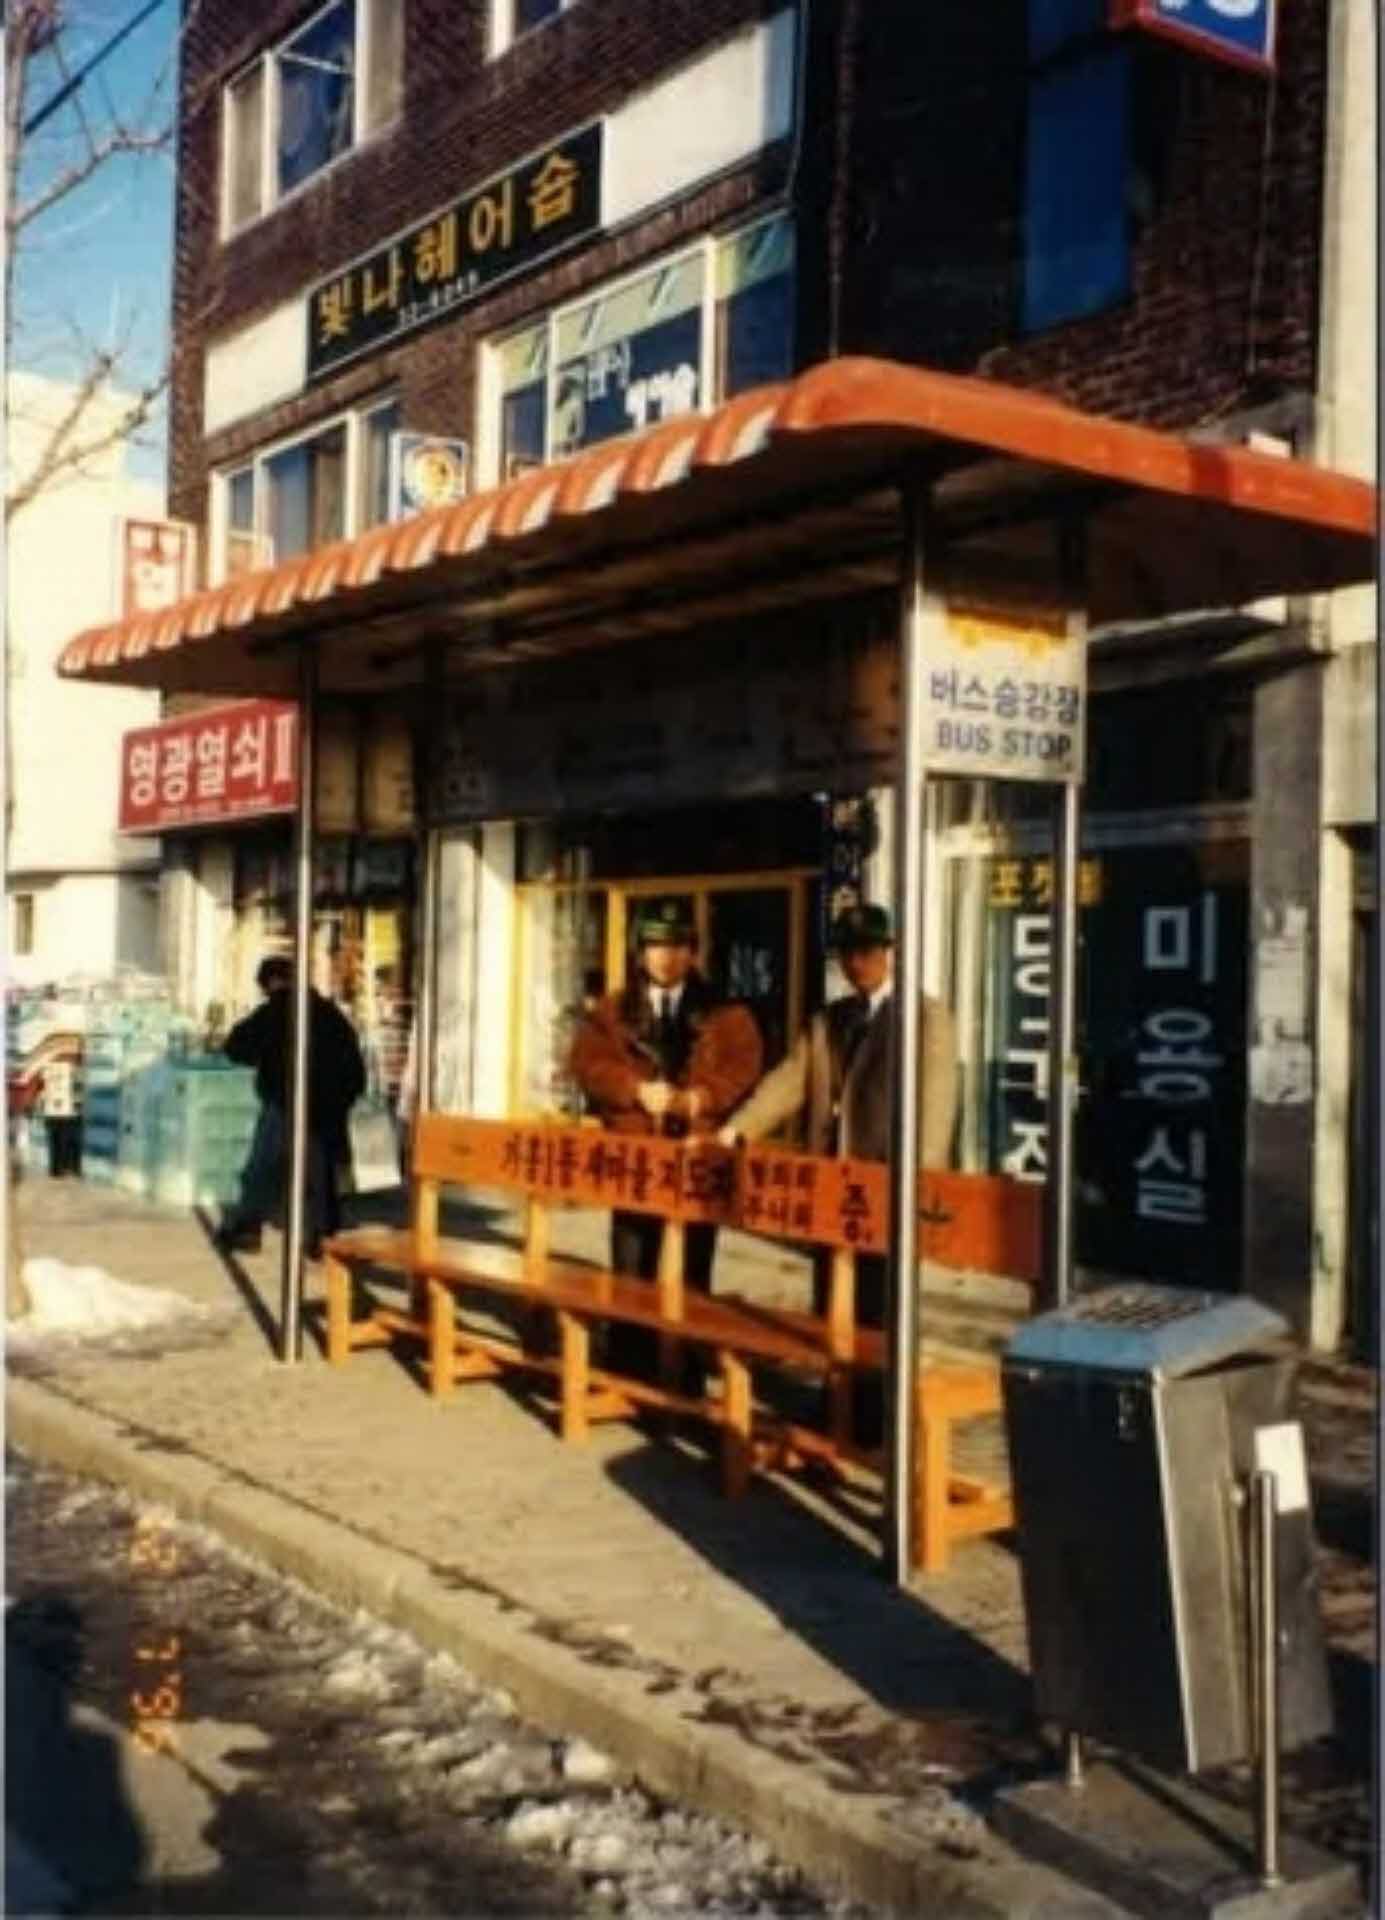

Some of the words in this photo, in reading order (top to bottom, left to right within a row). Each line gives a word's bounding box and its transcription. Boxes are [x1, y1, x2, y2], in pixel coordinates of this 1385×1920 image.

[937, 719, 993, 756] BUS
[1003, 728, 1073, 760] STOP
[1135, 890, 1224, 1224] 미용실
